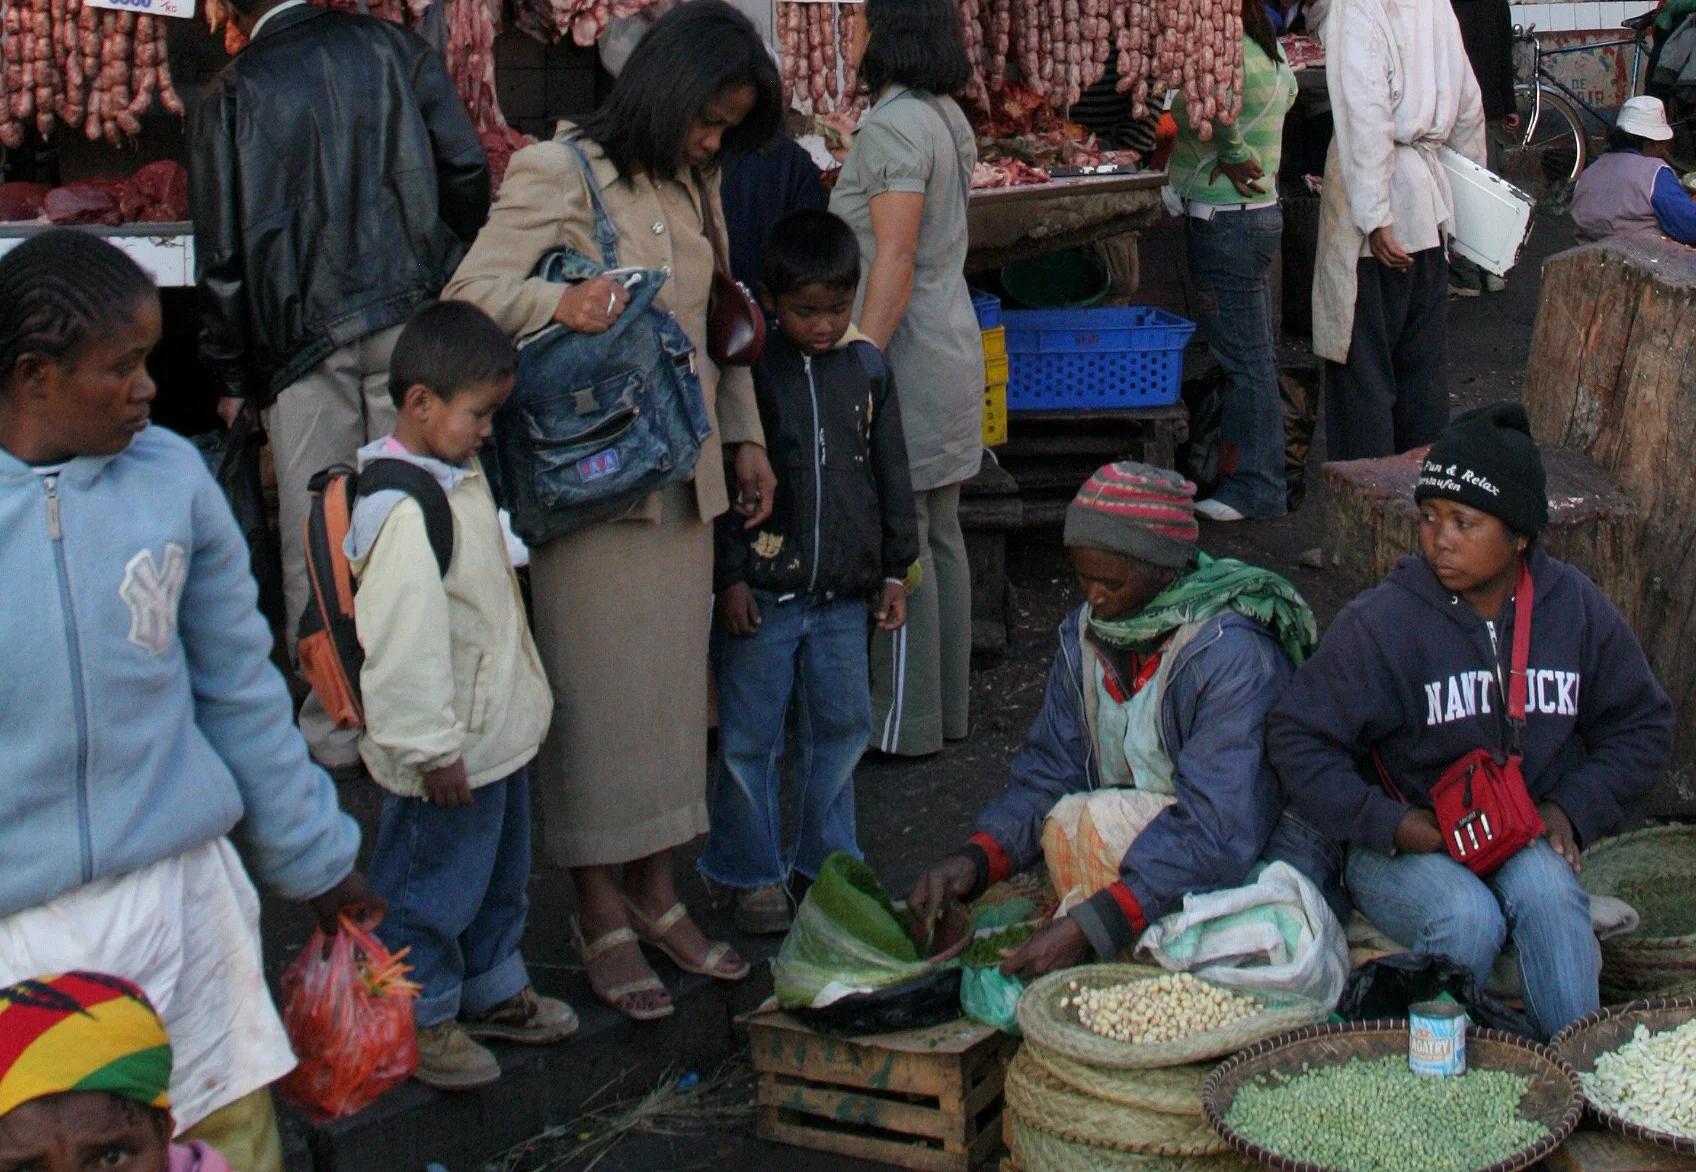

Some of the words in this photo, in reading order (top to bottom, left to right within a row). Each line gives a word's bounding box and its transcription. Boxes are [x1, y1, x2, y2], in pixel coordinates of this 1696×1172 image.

[1424, 460, 1442, 473] Fun
[1446, 464, 1457, 477] &
[1461, 469, 1500, 496] Relax
